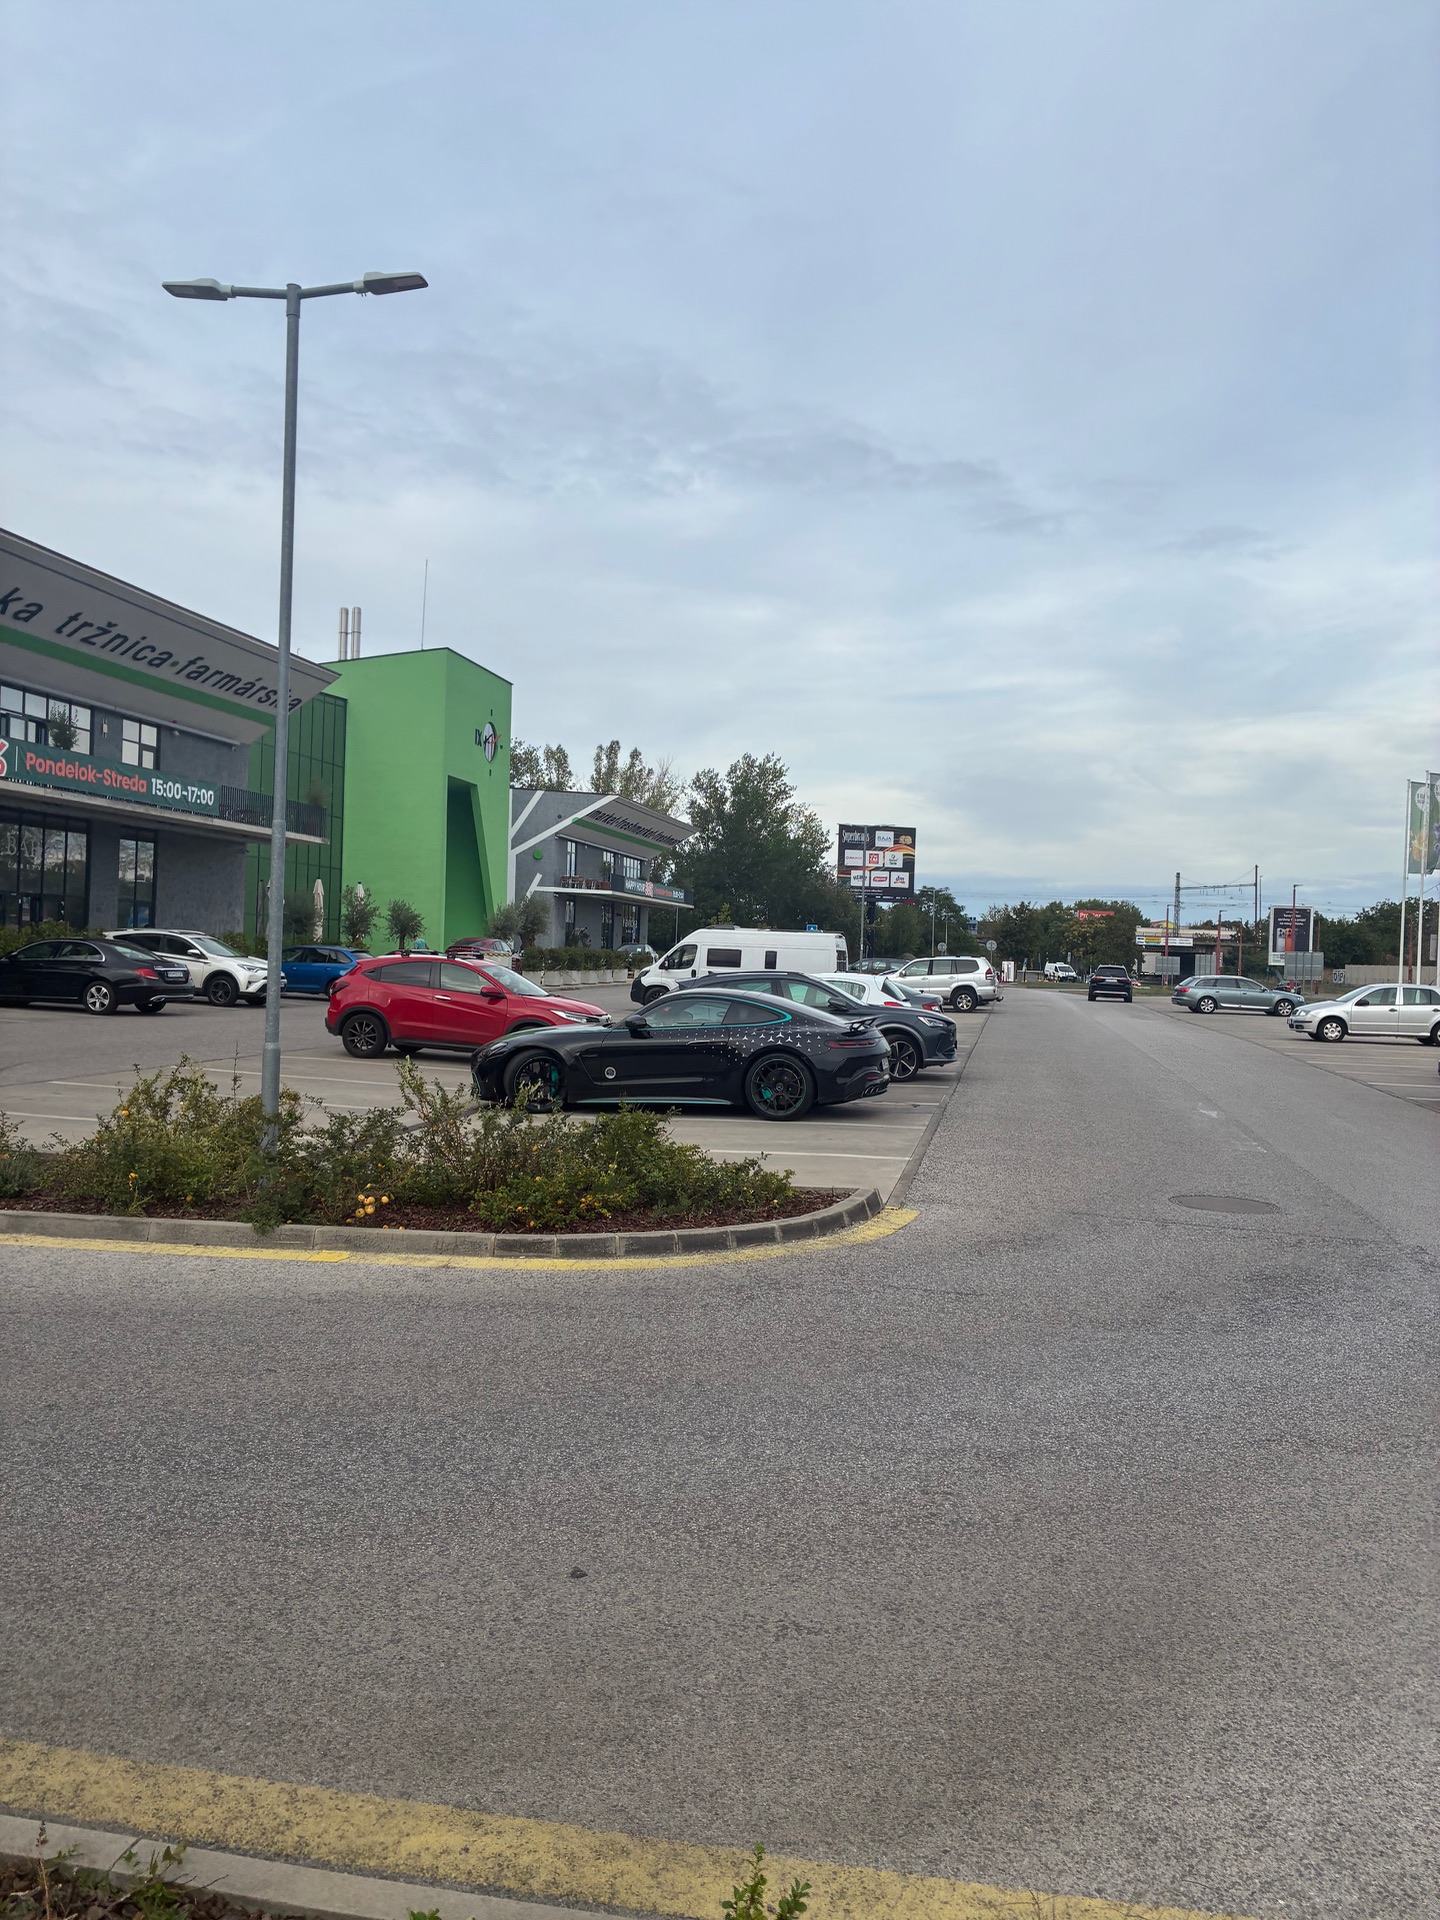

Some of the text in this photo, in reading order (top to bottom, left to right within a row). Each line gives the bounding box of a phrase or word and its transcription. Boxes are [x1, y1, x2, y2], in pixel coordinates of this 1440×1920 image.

[55, 612, 173, 668] tržnica
[175, 656, 302, 712] farmársa
[26, 752, 147, 793] Pondelok-Streda
[151, 778, 214, 806] 15:00-17:00
